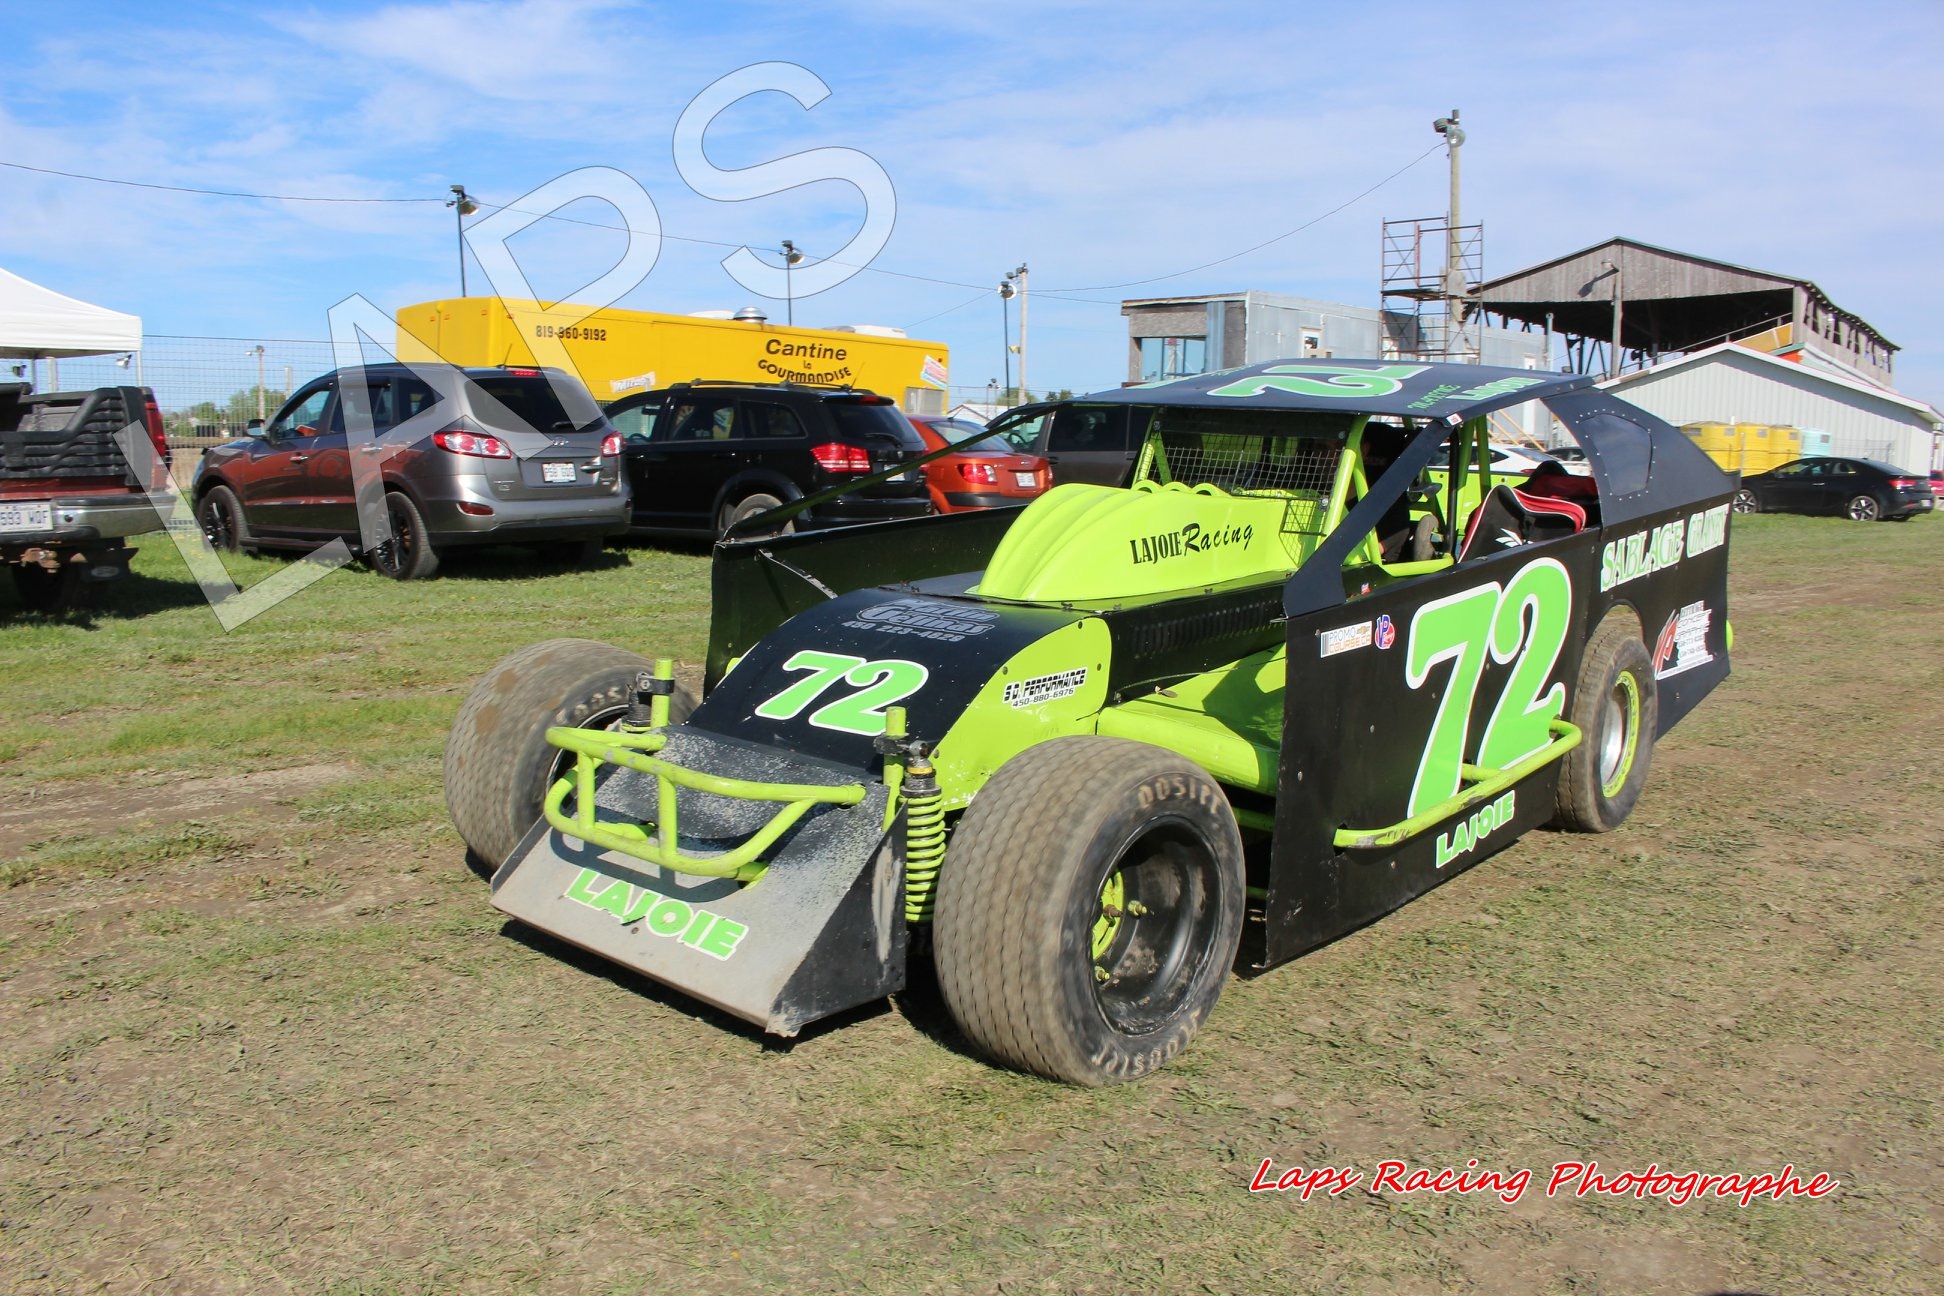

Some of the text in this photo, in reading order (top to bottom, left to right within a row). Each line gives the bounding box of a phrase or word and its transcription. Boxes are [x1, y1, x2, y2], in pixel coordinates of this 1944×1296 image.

[536, 325, 607, 341] 819-960-9192
[765, 338, 848, 361] Cantine
[758, 359, 852, 384] GOURMANDISE
[1129, 522, 1254, 565] LAJOIE Racing
[1600, 518, 1685, 592] SABLAGE
[1329, 627, 1356, 642] PROMO
[755, 650, 929, 737] 72
[1405, 556, 1572, 820] 72
[1435, 789, 1516, 869] LAJOIE
[563, 868, 750, 961] LAJOIE
